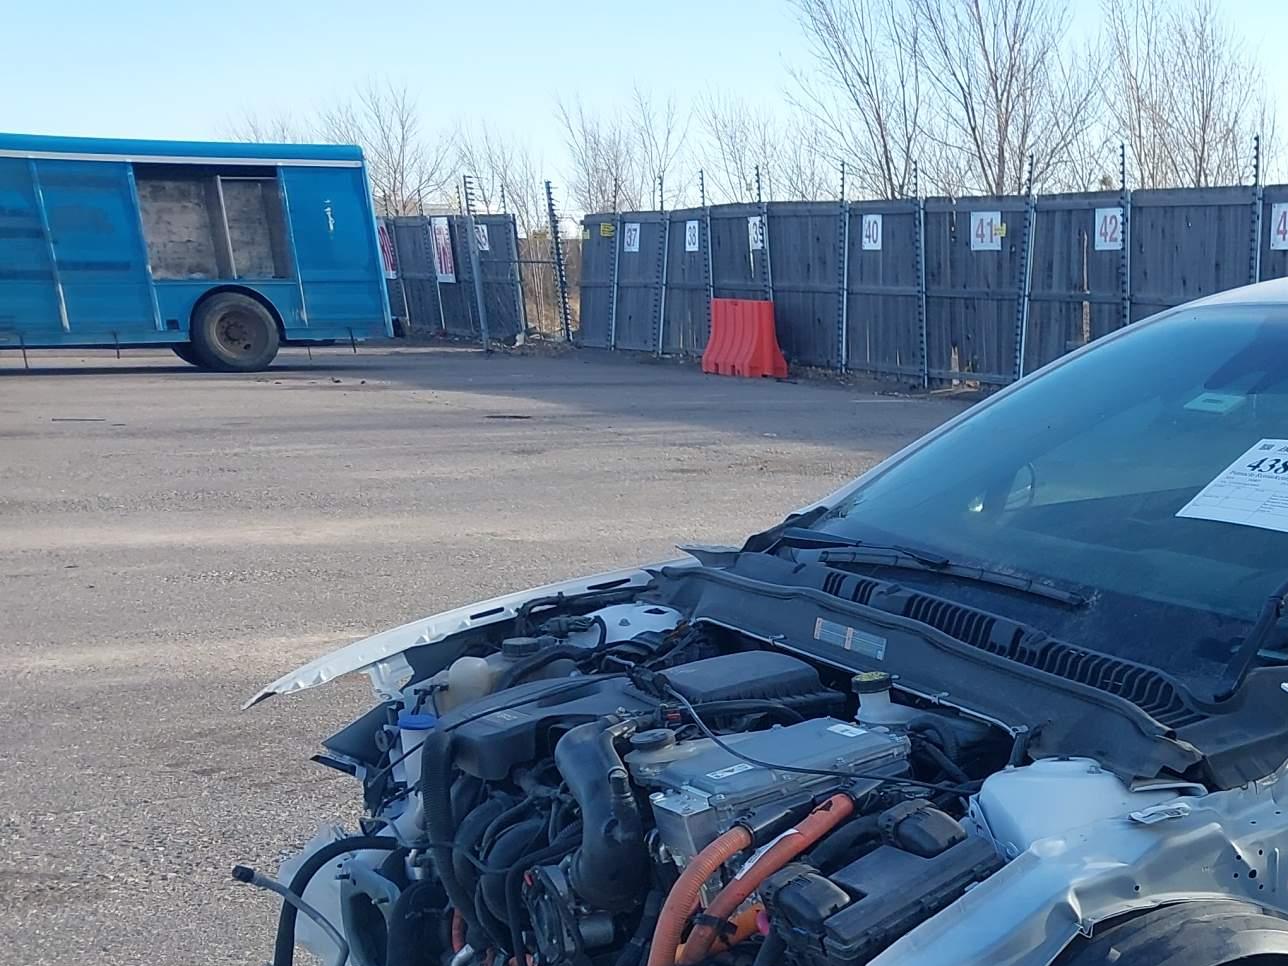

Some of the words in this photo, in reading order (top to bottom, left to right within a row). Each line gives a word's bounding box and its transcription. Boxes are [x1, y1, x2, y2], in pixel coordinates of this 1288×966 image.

[626, 227, 638, 247] 37
[864, 220, 879, 243] 40
[975, 218, 995, 243] 41
[1099, 214, 1119, 243] 42
